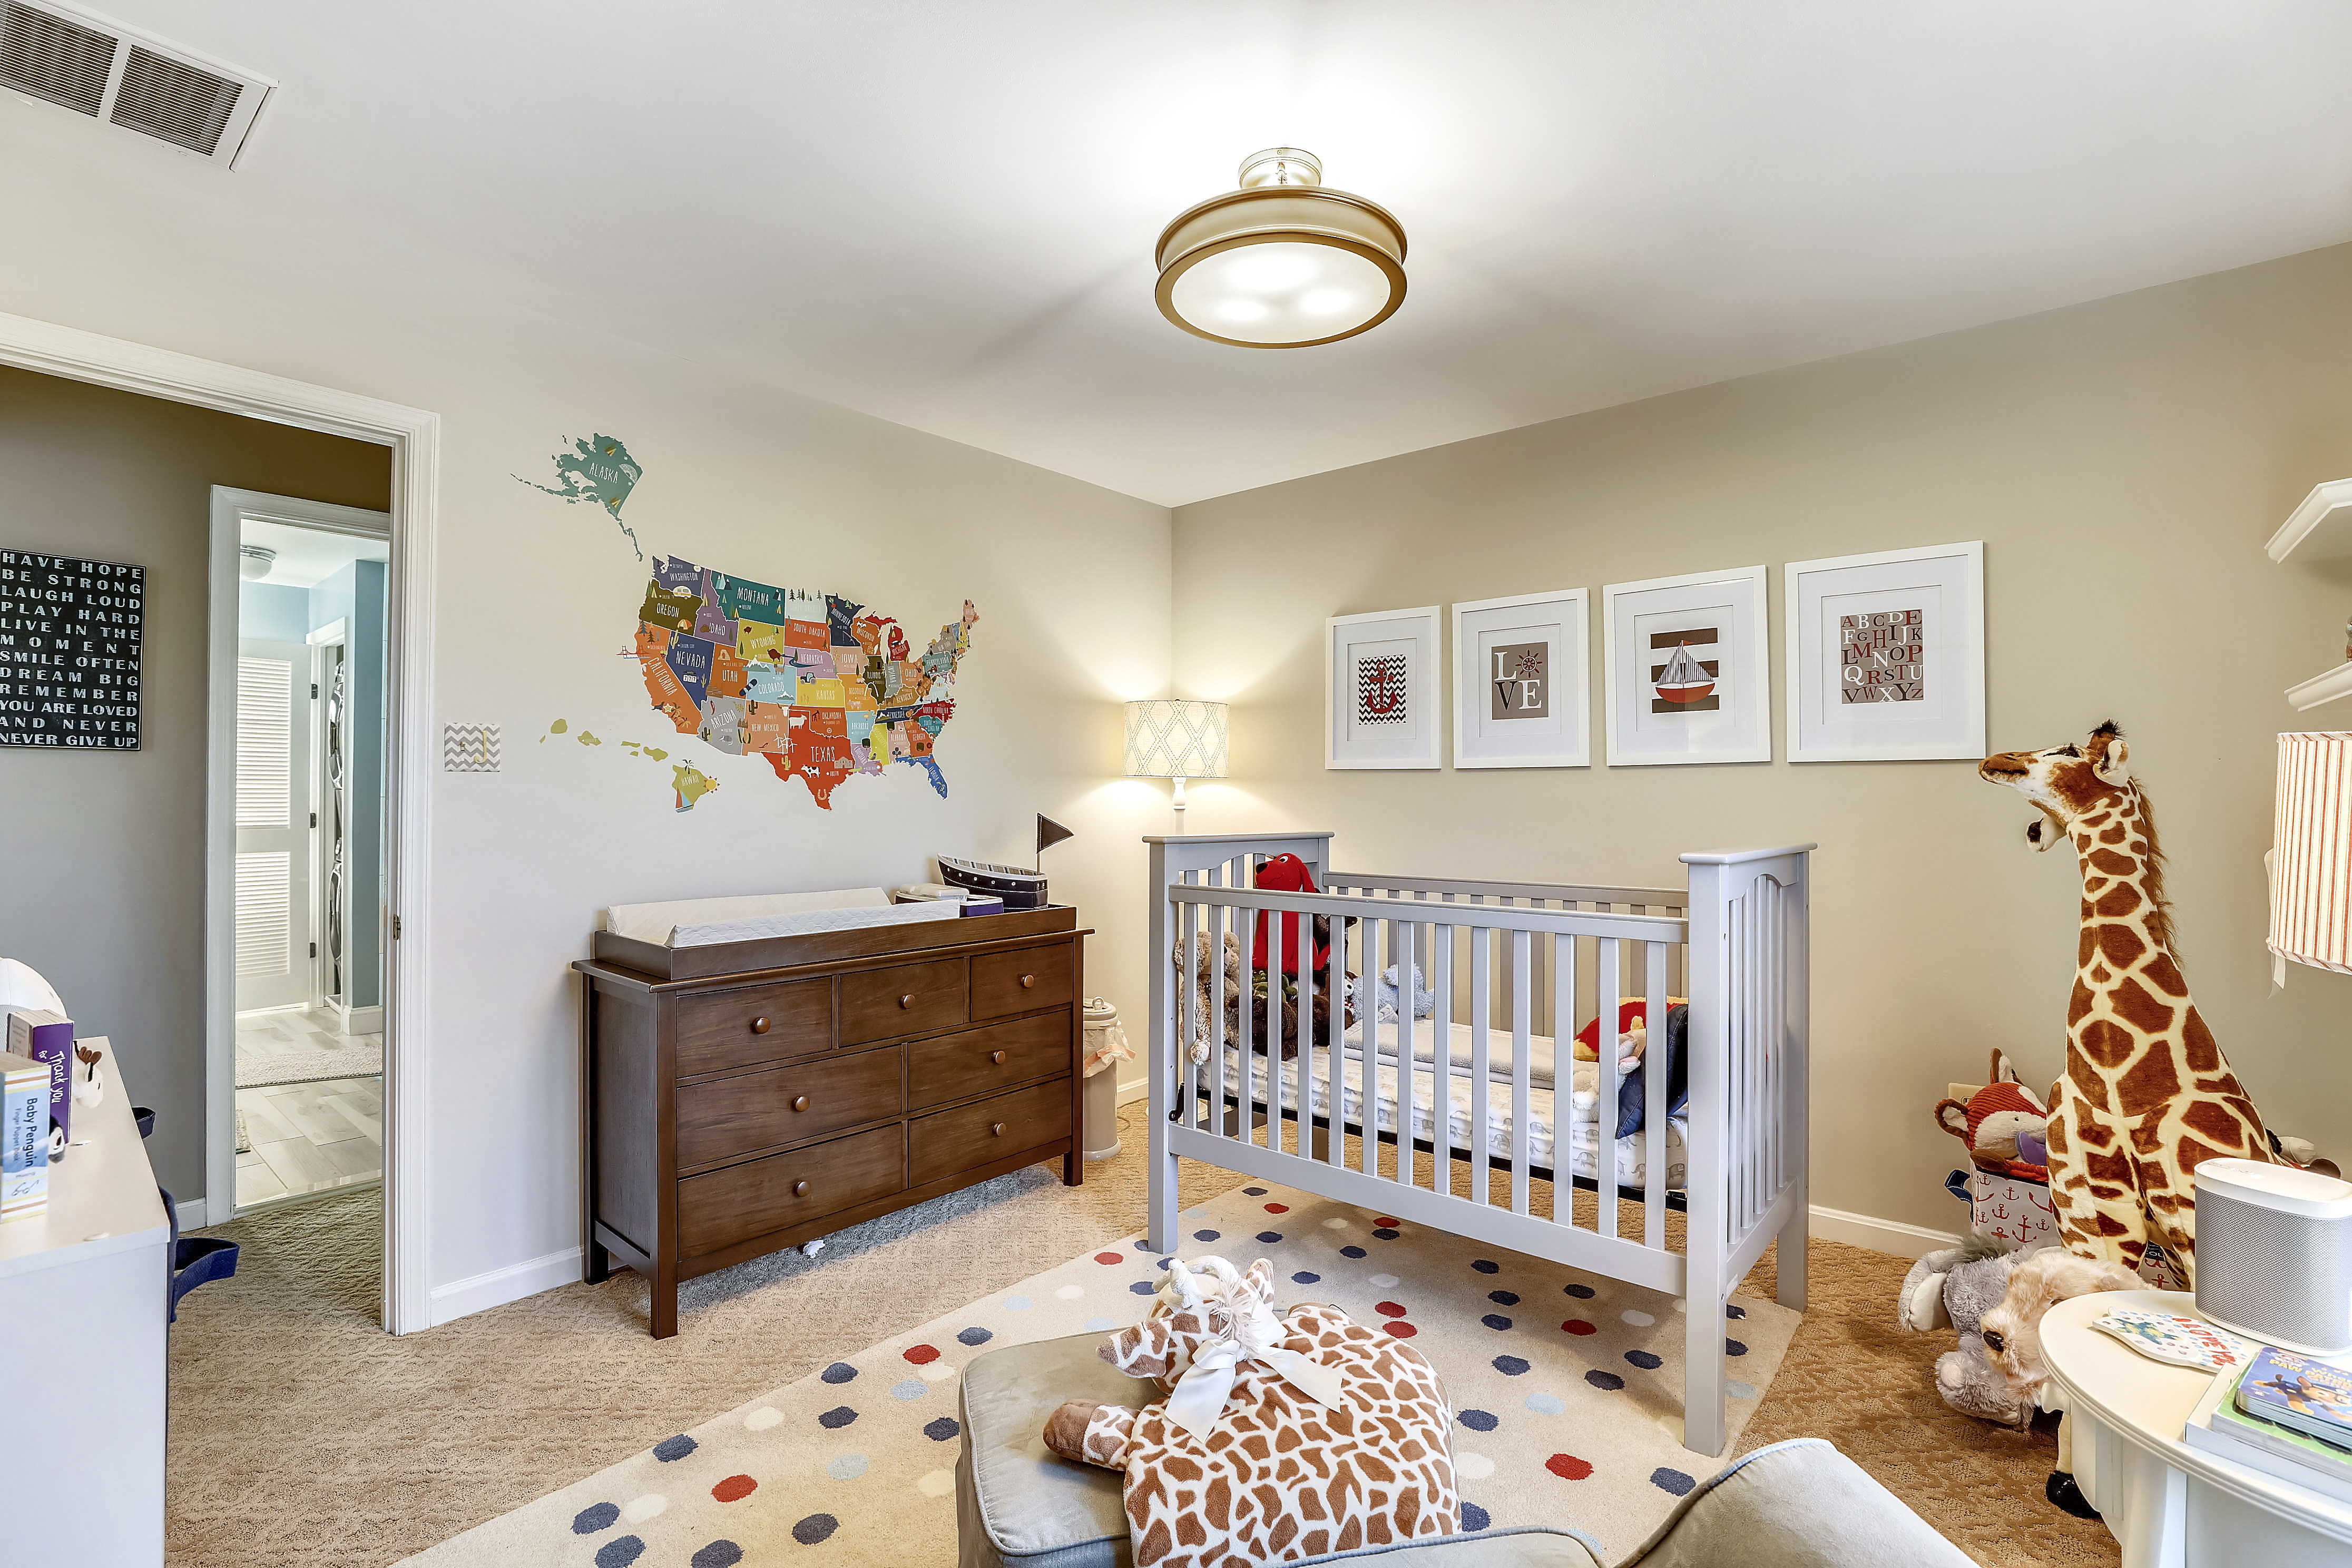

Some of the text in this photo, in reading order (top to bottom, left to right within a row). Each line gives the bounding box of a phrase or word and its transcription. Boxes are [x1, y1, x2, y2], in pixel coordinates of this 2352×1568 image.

[589, 463, 618, 484] ALASKA
[3, 553, 141, 579] HAVE HOPE
[2, 569, 141, 594] BE STRONG
[670, 573, 698, 582] WASHINGTON
[2, 585, 140, 609] LAUGH LOUD
[737, 587, 769, 606] MONTANA
[1, 602, 139, 624] PLAY HARD
[657, 603, 679, 618] OREGON
[831, 608, 851, 626] MINNESOTA
[1, 618, 139, 640] LIVE IN THE
[709, 622, 725, 635] IDAHO
[793, 623, 825, 638] SOUTH DAKOTA
[750, 635, 776, 649] WYOMING
[0, 651, 138, 671] SMILE OFTEN
[676, 651, 705, 669] NEVADA
[842, 654, 858, 663] IOWA
[0, 668, 138, 686] DREAM BIG
[648, 658, 678, 696] CALIFORNIA
[722, 670, 738, 682] UTAH
[0, 684, 138, 701] REMEMBER
[758, 682, 784, 694] COLORADO
[817, 690, 835, 700] KANSAS
[0, 700, 137, 717] YOU ARE LOVED
[0, 717, 137, 732] AND NEVER
[711, 710, 737, 729] ARIZONA
[0, 733, 137, 747] NEVER GIVE UP
[811, 747, 835, 762] TEXAS
[38, 1051, 47, 1059] for
[50, 1051, 68, 1103] Thank you
[24, 1098, 38, 1123] Baby
[23, 1126, 37, 1167] Penguin
[2269, 1359, 2303, 1373] PAW
